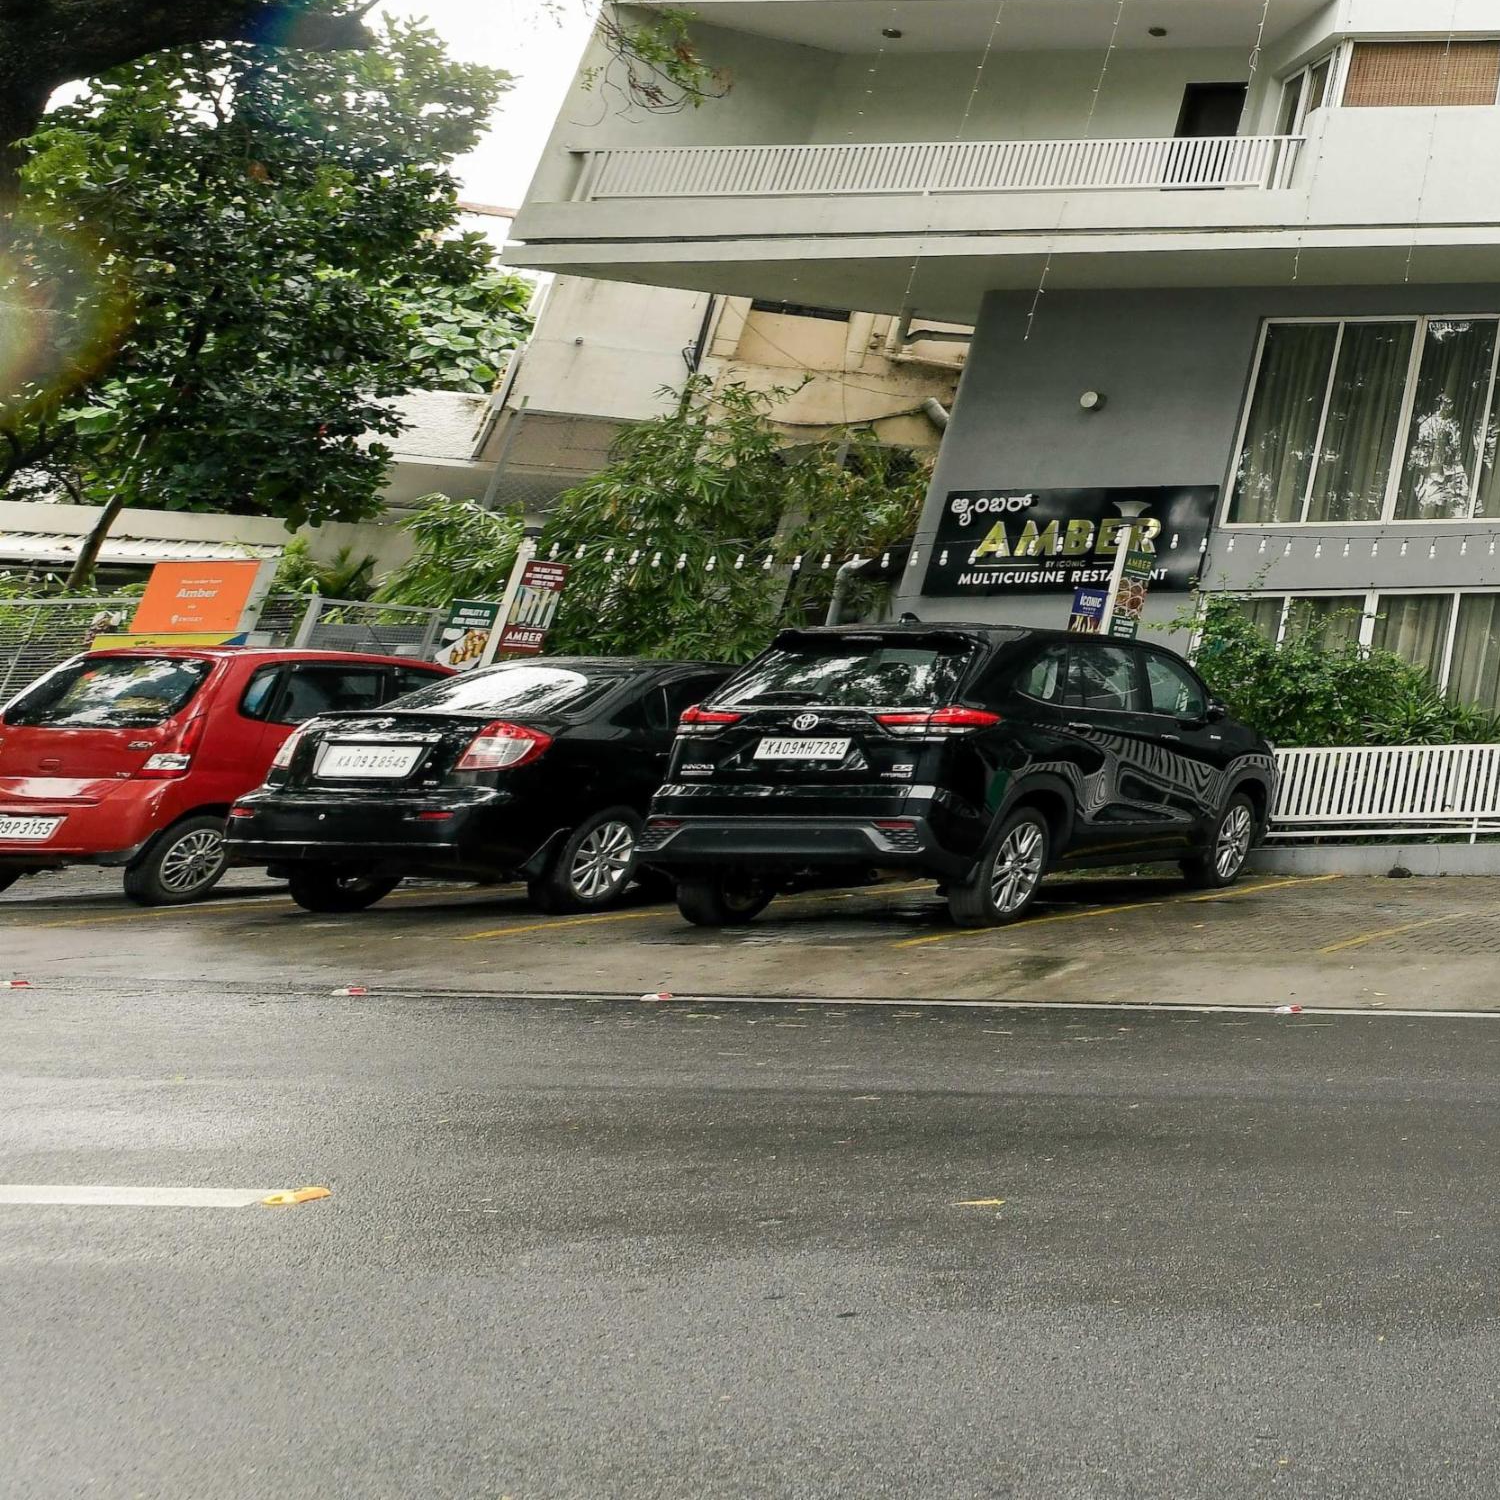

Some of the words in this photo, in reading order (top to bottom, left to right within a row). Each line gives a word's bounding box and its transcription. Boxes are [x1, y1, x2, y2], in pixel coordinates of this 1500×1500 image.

[975, 518, 1161, 558] AMBER
[1056, 559, 1086, 568] ICONIC
[958, 571, 1065, 585] MULTICUISINE
[1071, 568, 1168, 583] RESTANT
[176, 588, 218, 598] Amber
[1080, 592, 1103, 608] ICONIC
[504, 631, 542, 642] AMBER
[128, 740, 157, 748] ZEN
[765, 741, 846, 756] KA09MH7282
